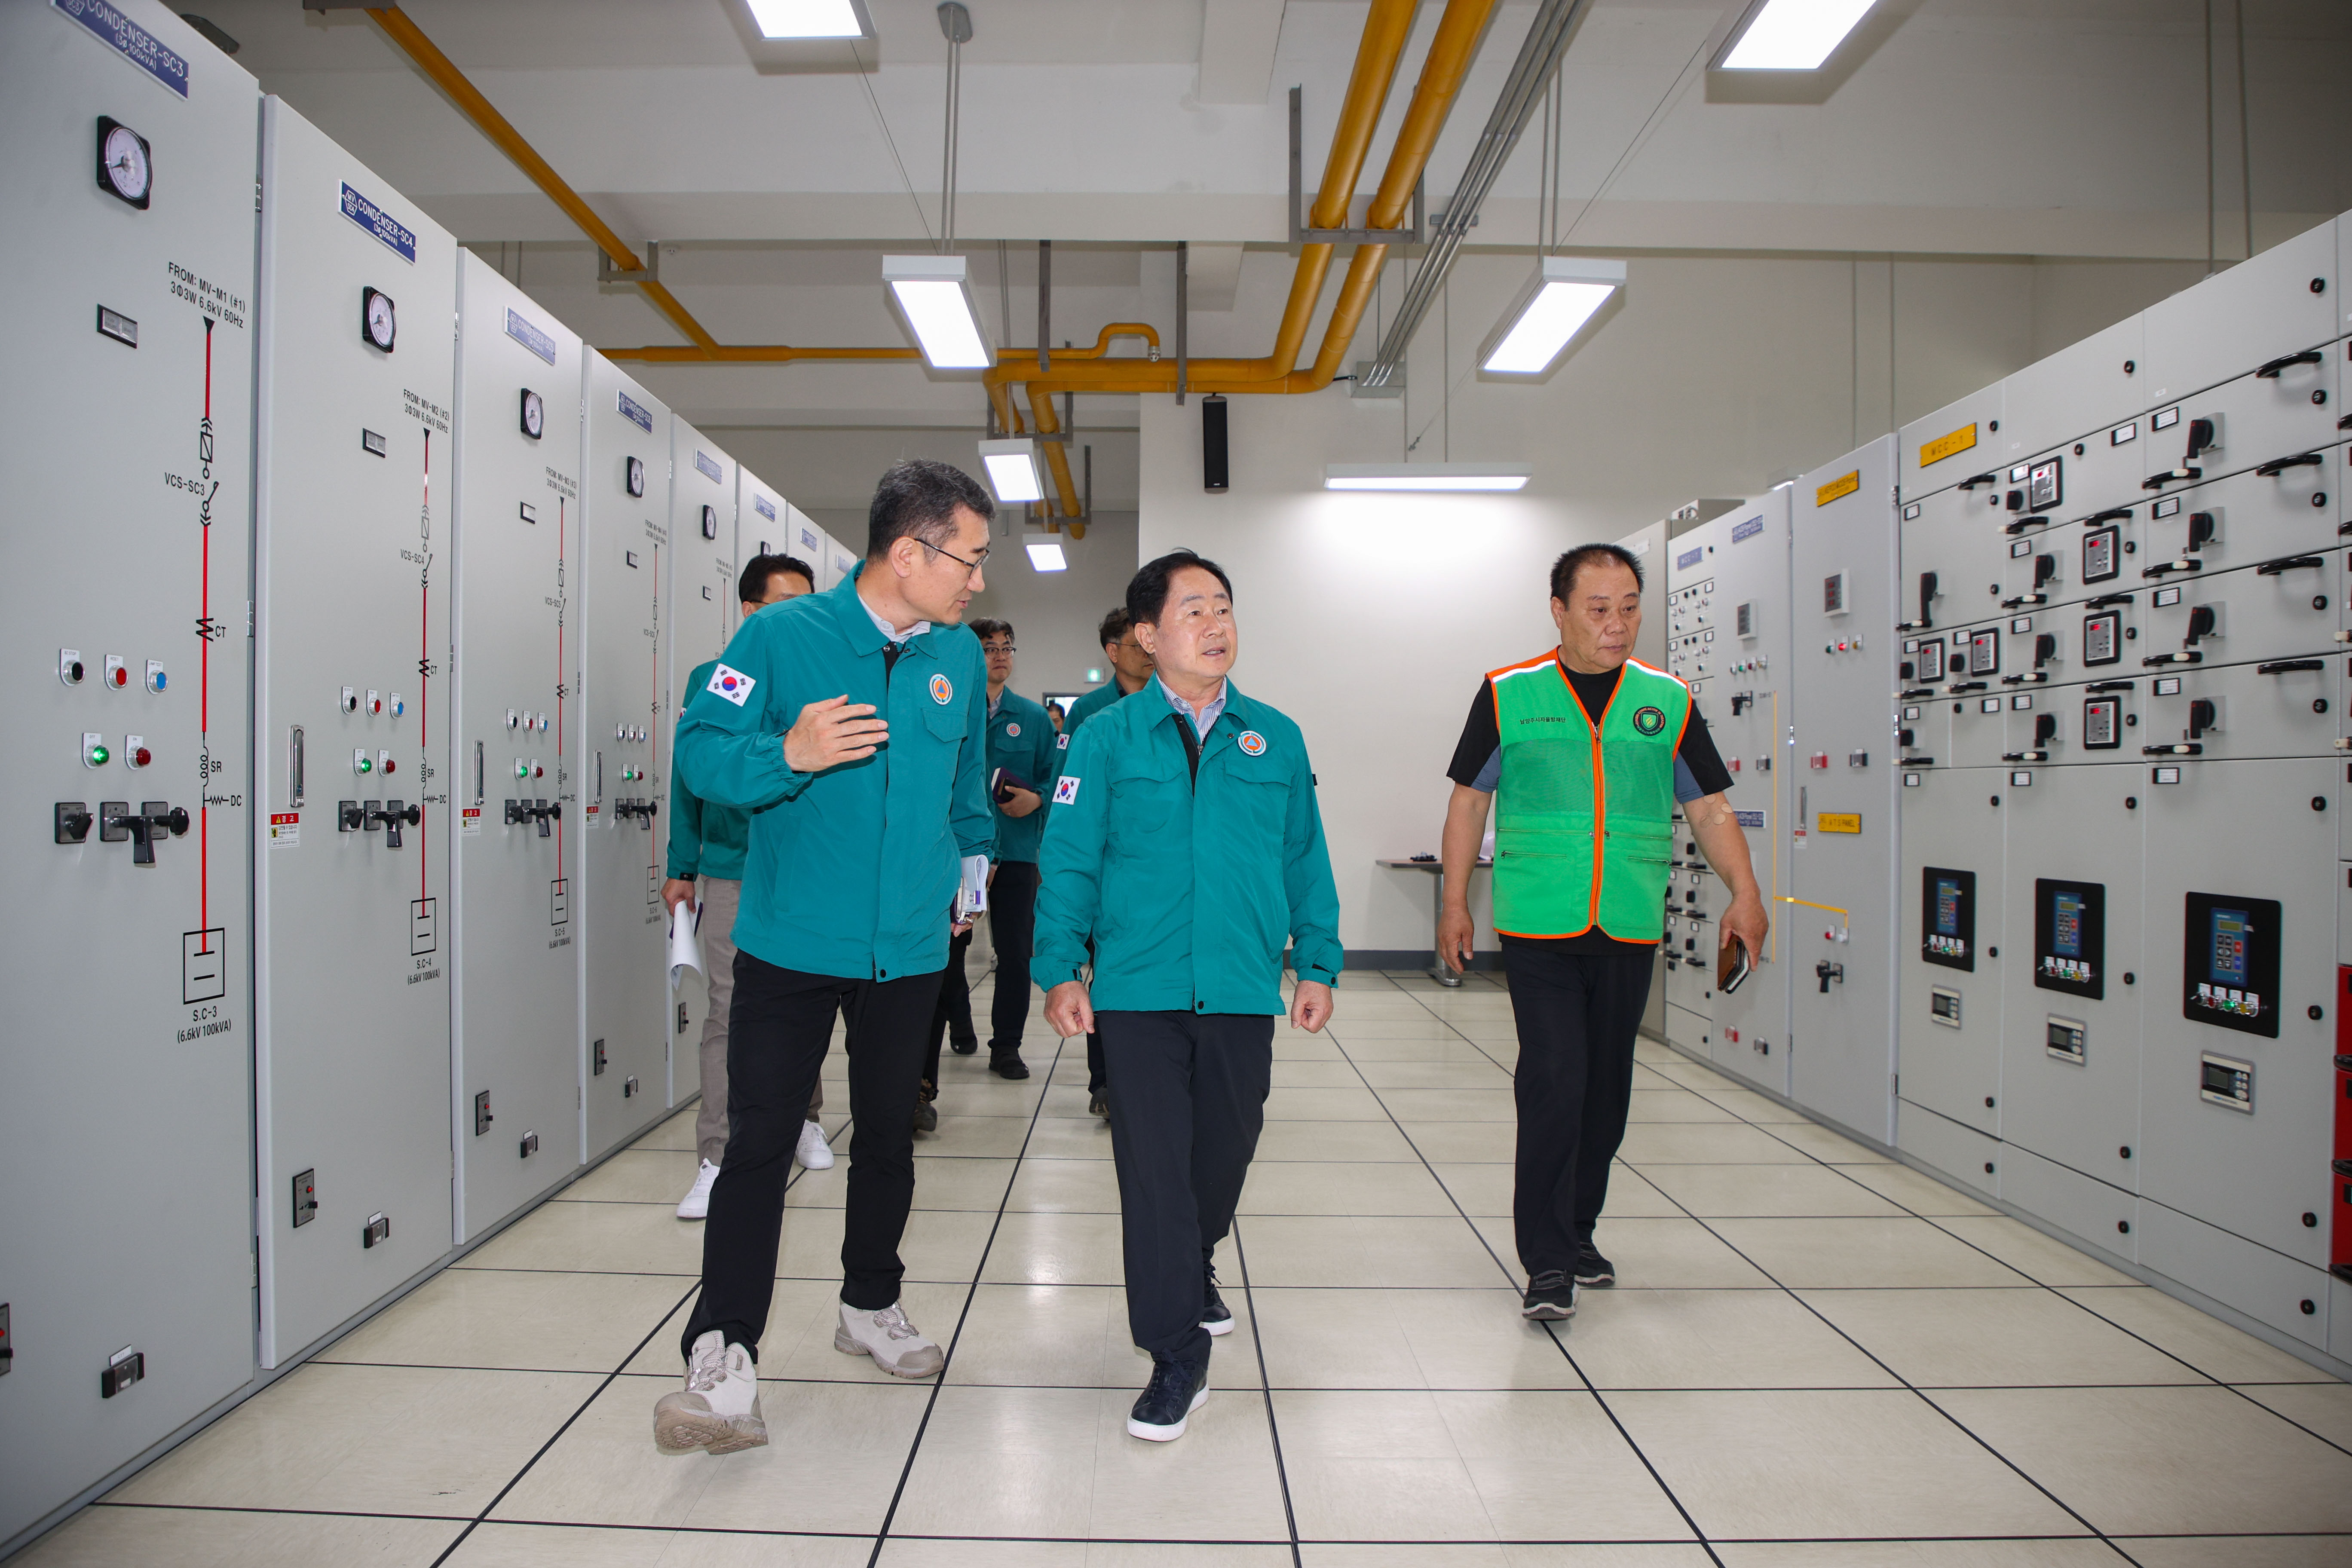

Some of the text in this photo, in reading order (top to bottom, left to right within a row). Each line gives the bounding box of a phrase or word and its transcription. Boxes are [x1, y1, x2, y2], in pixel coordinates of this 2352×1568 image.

[87, 0, 184, 77] CONDENSER-SC3
[129, 43, 157, 71] 100kVA)
[358, 199, 413, 248] CONDENSER-SC4
[382, 229, 398, 247] 100kVA)
[169, 261, 245, 314] FROM: MV-M1 (#1)
[199, 296, 222, 317] 6.6kV
[224, 309, 243, 329] 60Hz
[404, 388, 450, 422] FROM: MV-M2 (#2)
[422, 412, 435, 427] 6.6kV
[437, 420, 448, 434] 60Hz
[165, 472, 205, 496] VCS-SC3
[401, 548, 424, 565] VCS-SC4
[216, 625, 226, 637] CT
[431, 665, 438, 675] CT
[1520, 717, 1566, 725] 남양주시자율방재단
[211, 761, 222, 772] SR
[427, 769, 434, 778] SR
[231, 795, 242, 806] DC
[439, 795, 447, 804] DC
[417, 958, 432, 969] S.C-4
[407, 968, 440, 986] (6.6kV 100kVA)
[193, 1005, 217, 1022] S.C-3
[177, 1018, 232, 1044] (6.6kV 100kVA)
